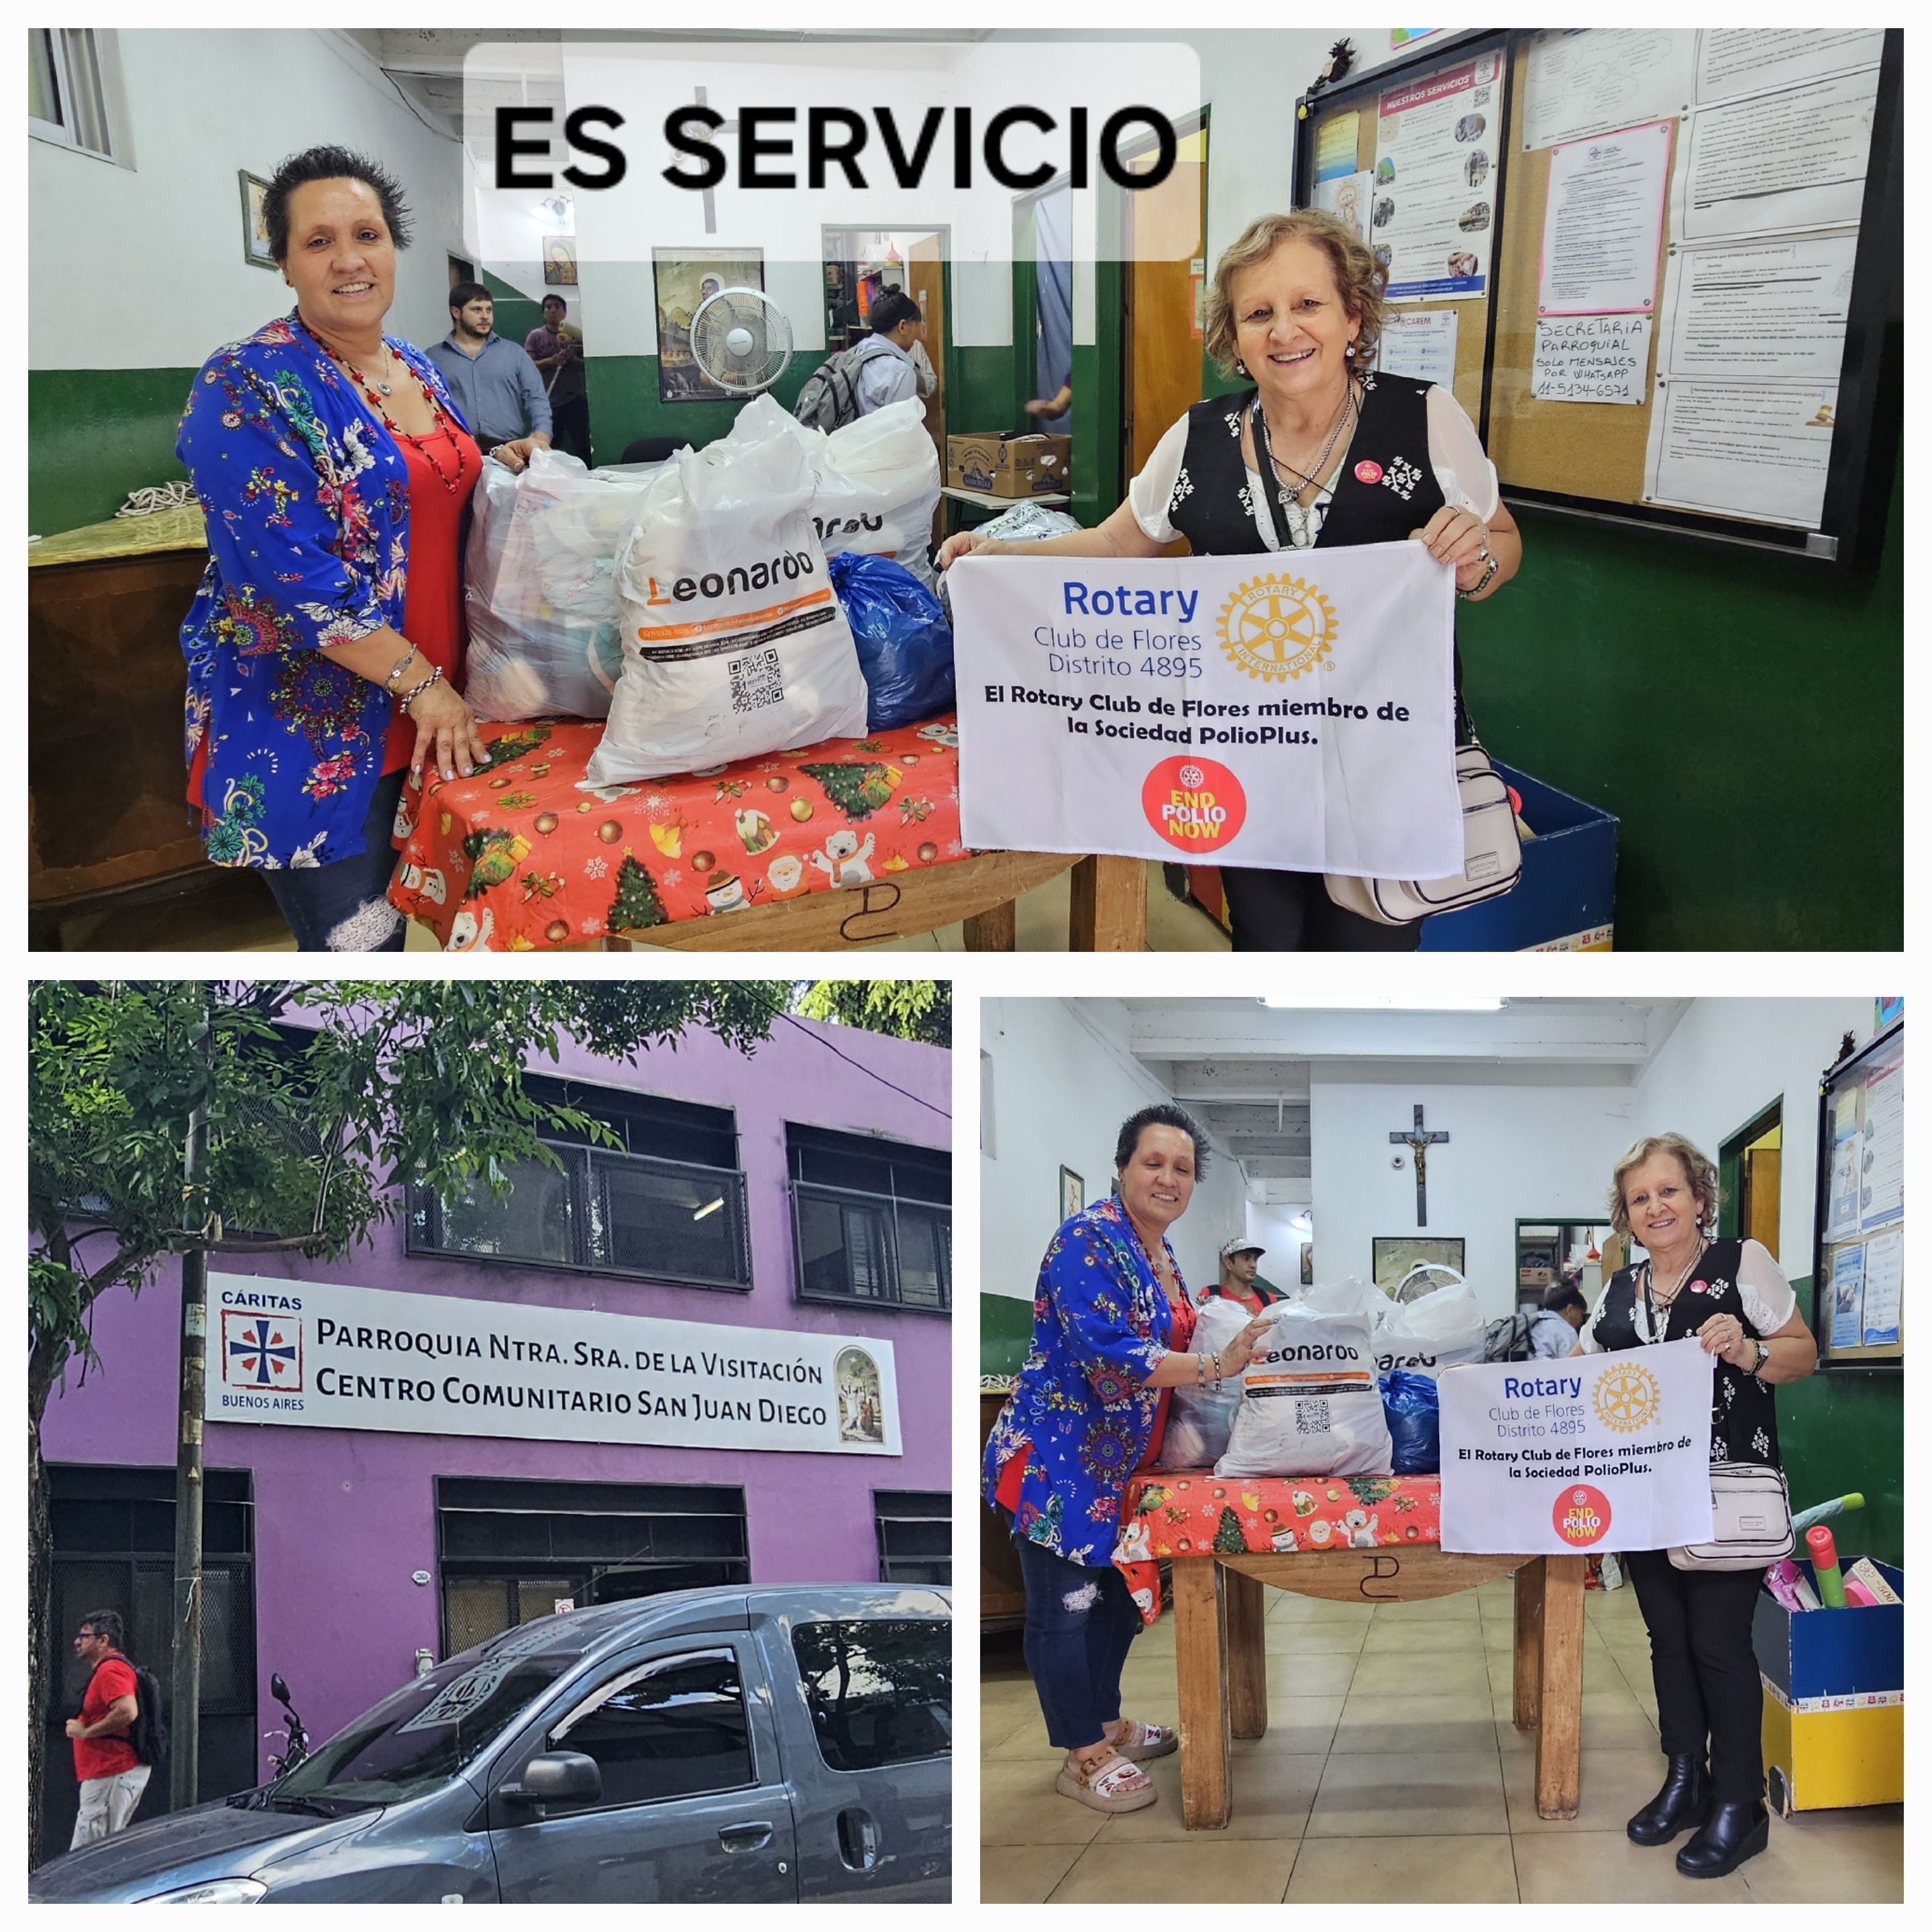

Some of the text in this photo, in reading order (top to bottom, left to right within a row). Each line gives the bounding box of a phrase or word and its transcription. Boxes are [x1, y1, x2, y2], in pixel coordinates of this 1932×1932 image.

[1387, 75, 1470, 110] NUESTROS SERVICIOS
[1407, 317, 1432, 326] CAREM
[1541, 318, 1642, 336] SECRETARIA
[1542, 339, 1629, 354] PARROQUIAL
[1536, 356, 1637, 367] SOLO MENSAJES
[1544, 369, 1567, 377] POR
[1538, 381, 1629, 397] 11-5134-6571
[647, 550, 813, 605] Leonardo
[1064, 582, 1198, 623] Rotary
[1247, 585, 1299, 601] ROTARY
[1034, 627, 1202, 652] Club de Flores
[1237, 637, 1321, 672] INTERNATIONAL
[1049, 653, 1203, 679] Distrito 4895
[985, 686, 1410, 722] El Rotary Club de Flores miembro de
[1068, 715, 1319, 746] la Sociedad PolioPlus.
[1171, 790, 1216, 809] END
[1162, 804, 1226, 824] POLIO
[1168, 820, 1220, 840] NOW
[221, 1289, 303, 1311] CÁRITAS
[317, 1318, 824, 1385] PARROQUIA NTRA. SRA. DE LA VISITACIÓN
[1609, 1368, 1637, 1381] ROTARY
[315, 1367, 827, 1426] CENTRO COMUNITARIO SAN JUAN DIEGO
[1505, 1377, 1582, 1399] Rotary
[222, 1393, 305, 1411] BUENOS AIRES
[1489, 1403, 1585, 1421] Club de Flores
[1604, 1405, 1650, 1427] INTERNATIONAL
[1498, 1419, 1586, 1437] Distrito 4895
[1458, 1436, 1692, 1462] El Rotary Club de Flores miembro de
[1509, 1462, 1652, 1478] la Sociedad PolioPlus.
[1568, 1507, 1595, 1519] END
[1562, 1517, 1601, 1529] POLIO
[1567, 1527, 1597, 1538] NOW
[1878, 1585, 1895, 1603] 500
